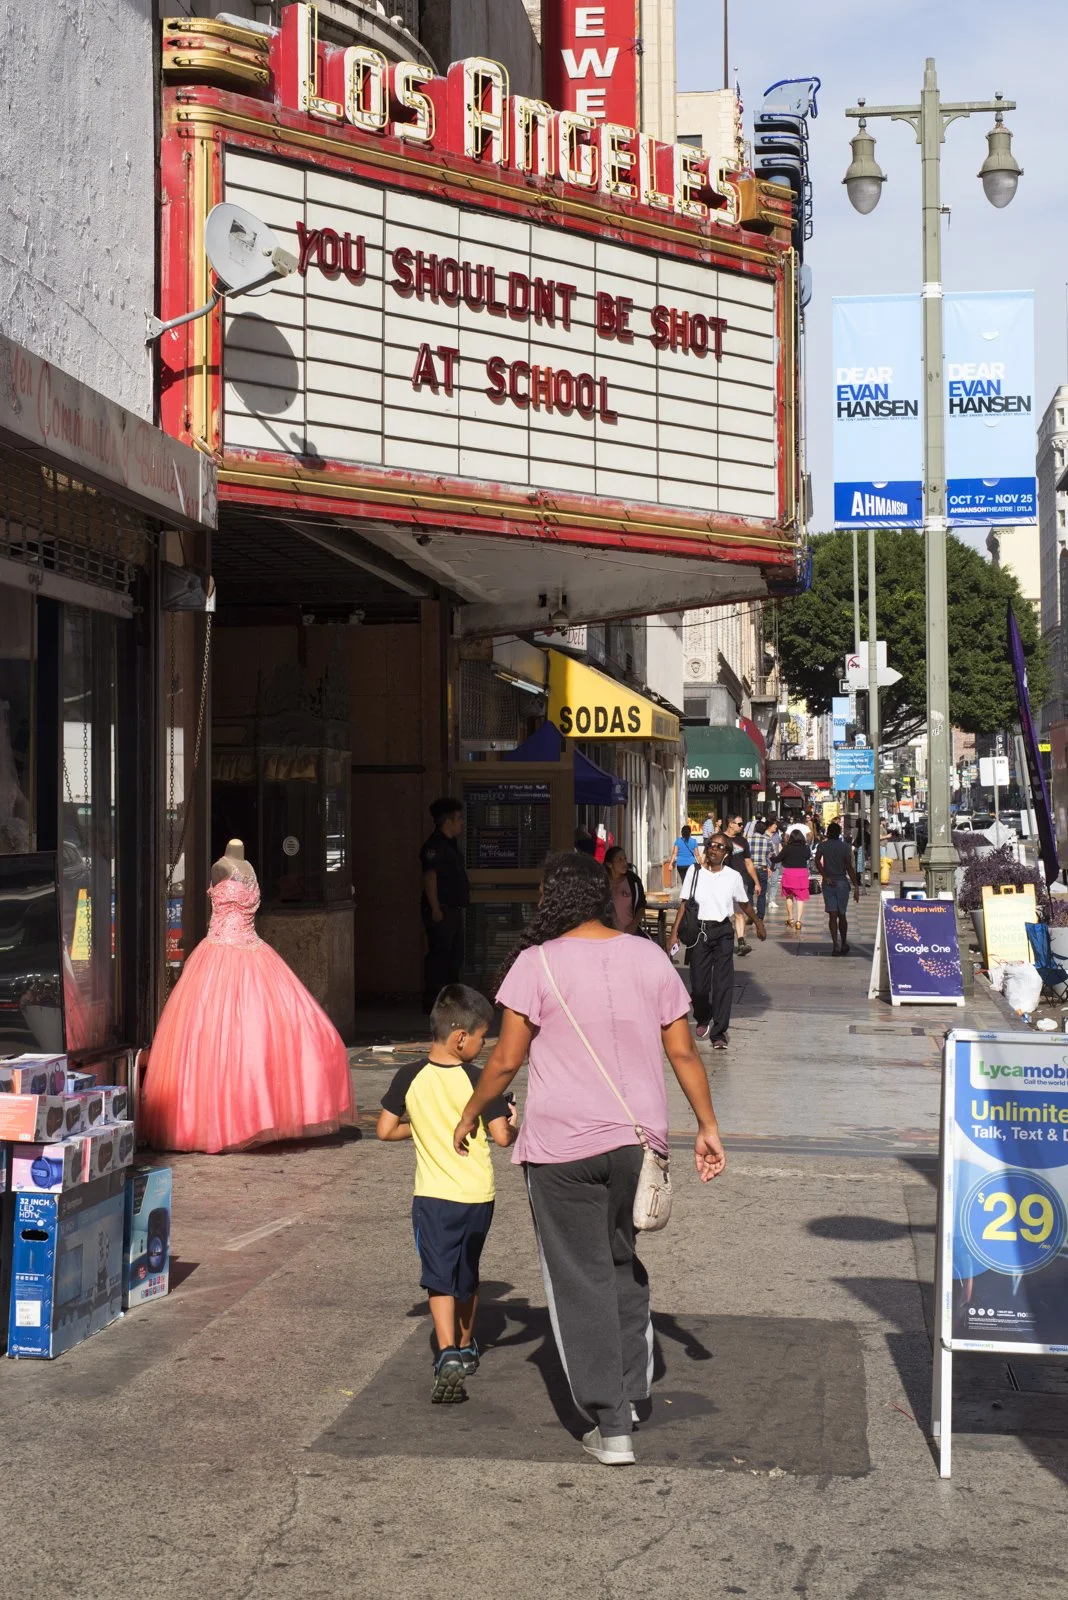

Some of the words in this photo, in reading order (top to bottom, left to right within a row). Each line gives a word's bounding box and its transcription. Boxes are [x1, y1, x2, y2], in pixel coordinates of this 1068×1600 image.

[296, 2, 436, 144] LOS
[463, 56, 743, 225] ANGELES
[296, 221, 366, 278] YOU
[391, 246, 577, 328] SHOULDNT
[596, 291, 634, 339] BE
[650, 304, 728, 360] SHOT
[836, 366, 893, 384] DEAR
[948, 362, 1004, 380] DEAR
[412, 342, 460, 394] AT
[485, 356, 618, 424] SCHOOL
[836, 383, 889, 401] EVAN
[948, 379, 1001, 397] EVAN
[837, 399, 918, 418] HANSEN
[949, 395, 1031, 414] HANSEN
[851, 491, 908, 517] AHMANSON
[950, 495, 972, 504] OCT
[974, 495, 984, 504] 17
[995, 494, 1018, 504] NOV
[1021, 494, 1032, 503] 25
[559, 705, 641, 734] SODAS
[708, 783, 729, 792] SHOP
[891, 905, 906, 913] Get
[912, 906, 928, 914] plan
[894, 943, 929, 955] Google
[931, 944, 951, 953] One
[971, 1125, 1007, 1141] Talk,
[1011, 1126, 1043, 1141] Text
[1047, 1128, 1058, 1141] &
[19, 1197, 29, 1205] 32
[30, 1198, 50, 1206] INCH
[19, 1204, 35, 1212] LED
